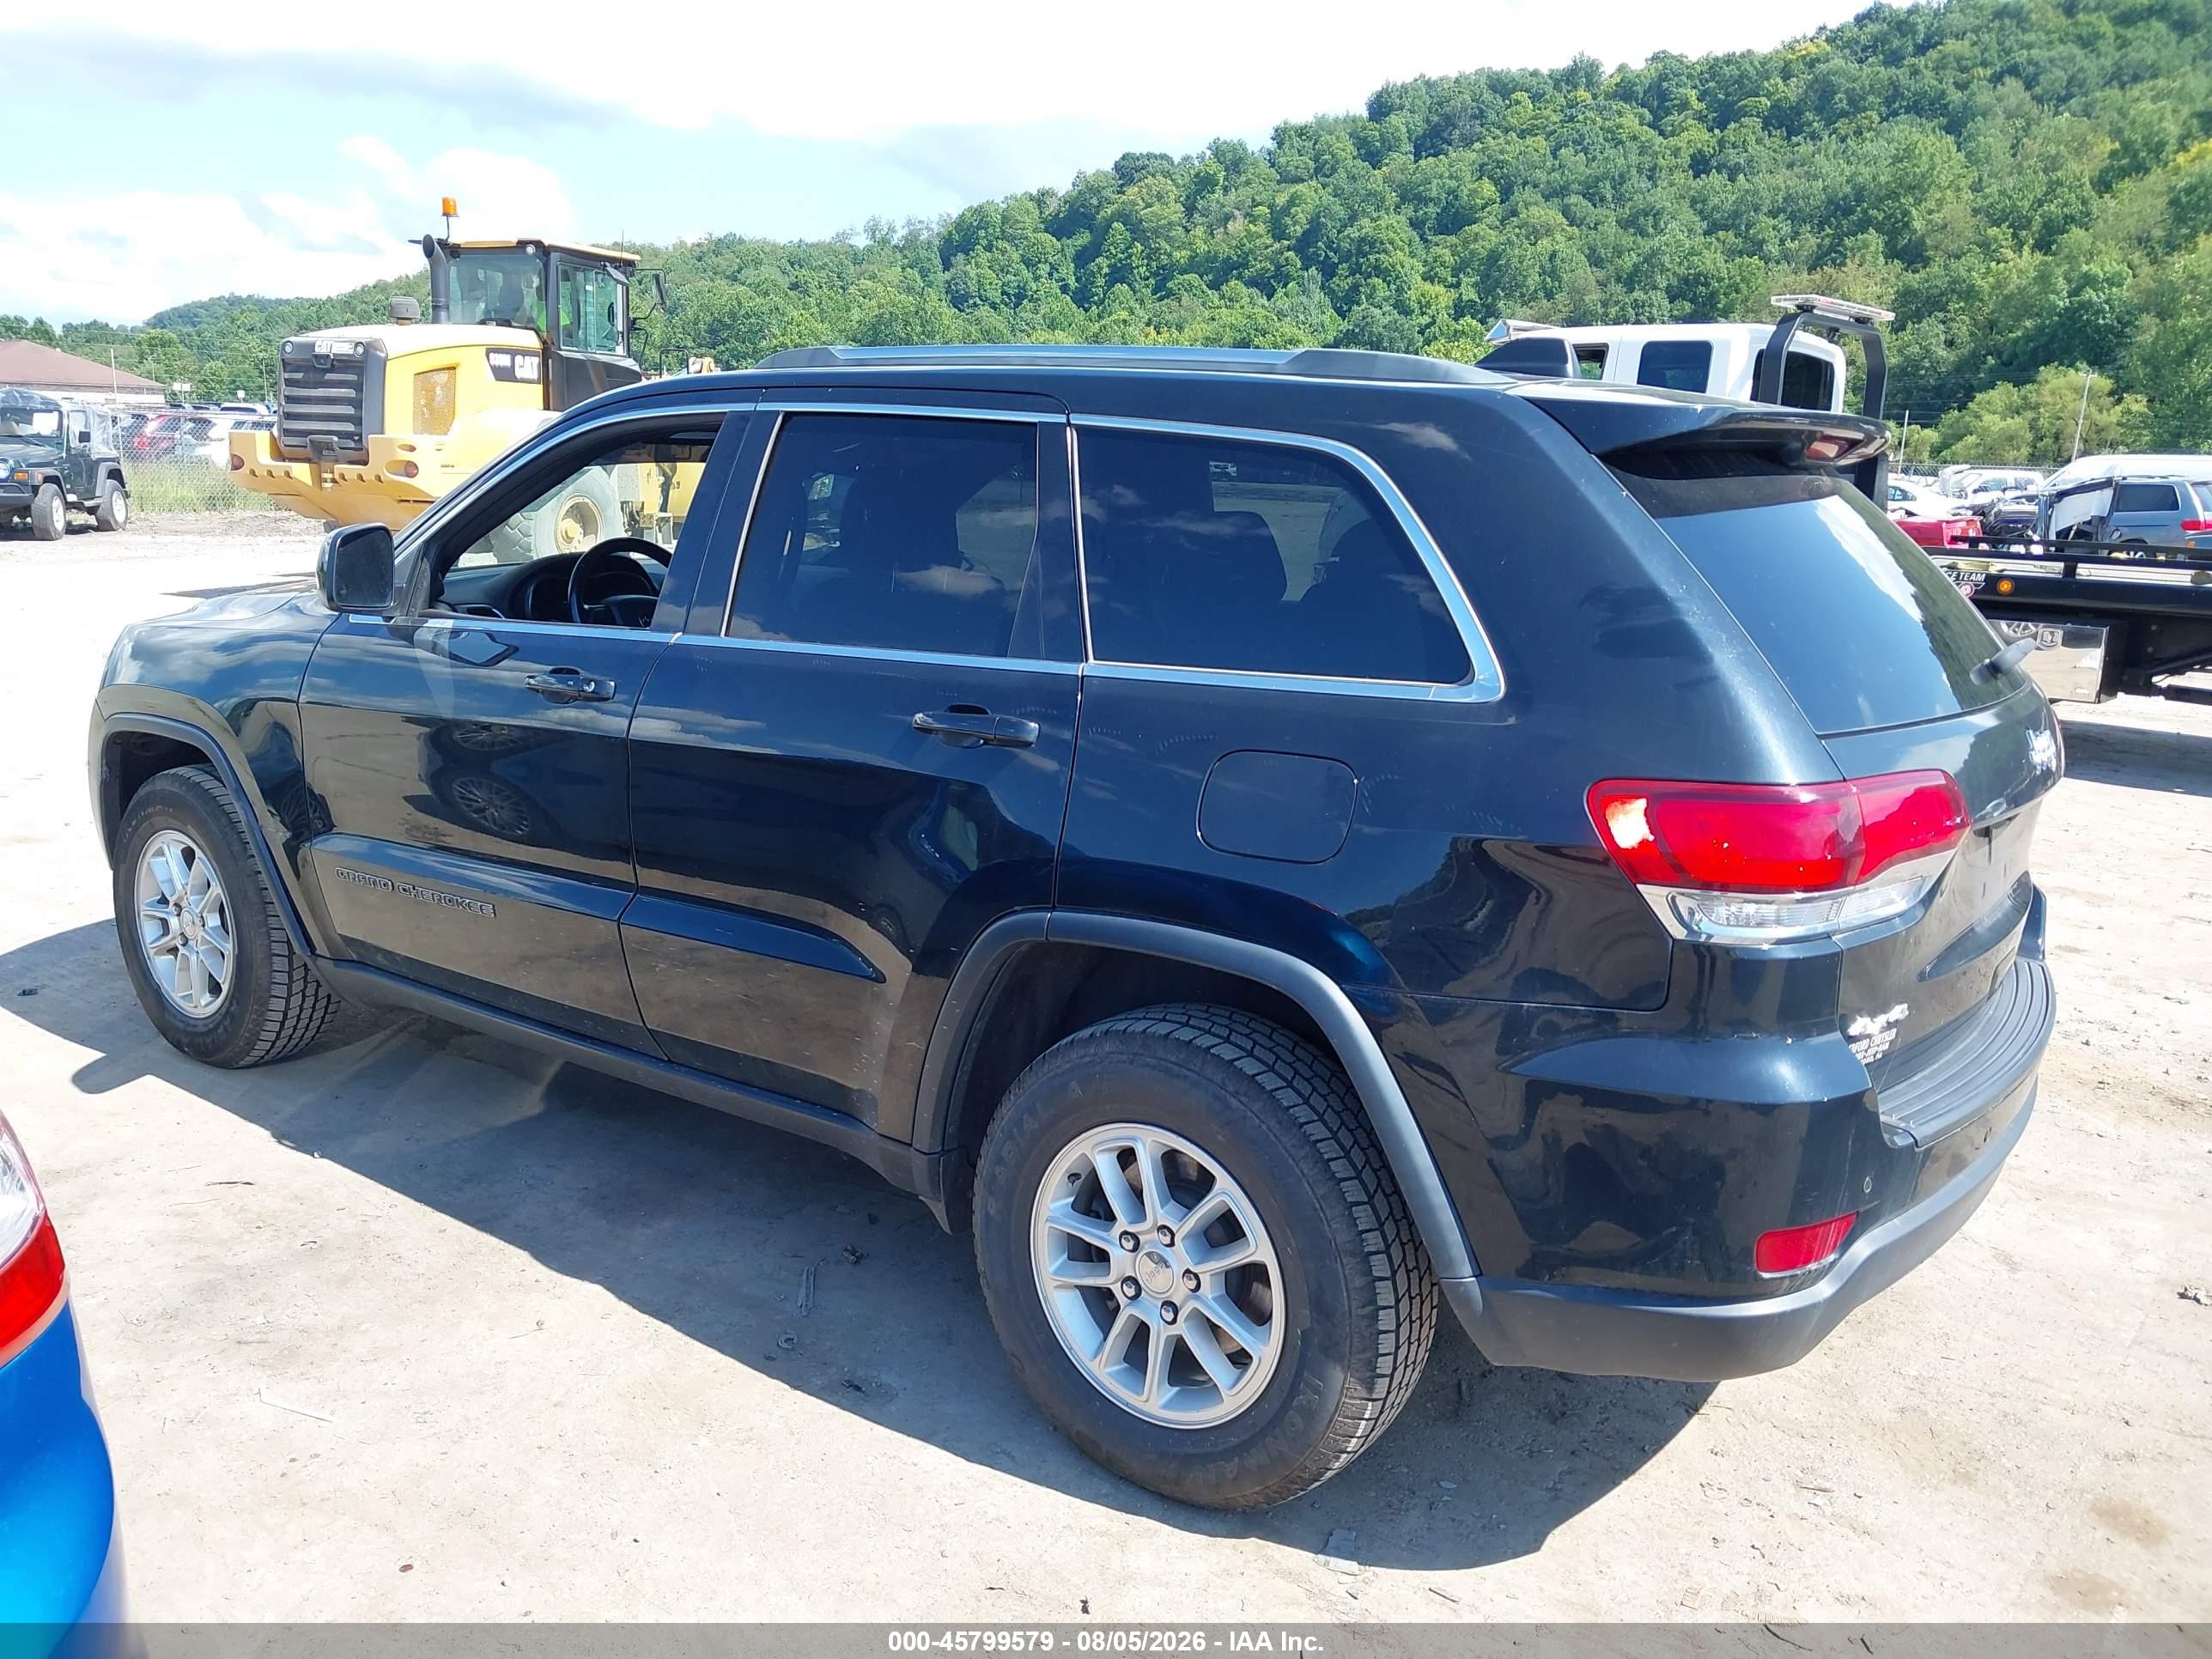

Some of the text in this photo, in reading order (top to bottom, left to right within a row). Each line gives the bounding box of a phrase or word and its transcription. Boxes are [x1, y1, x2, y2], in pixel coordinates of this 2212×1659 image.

[514, 355, 539, 380] CAT
[1959, 572, 1986, 581] TEAM
[335, 866, 496, 918] GRAND CHEROKEE
[1144, 1261, 1166, 1285] Jeep
